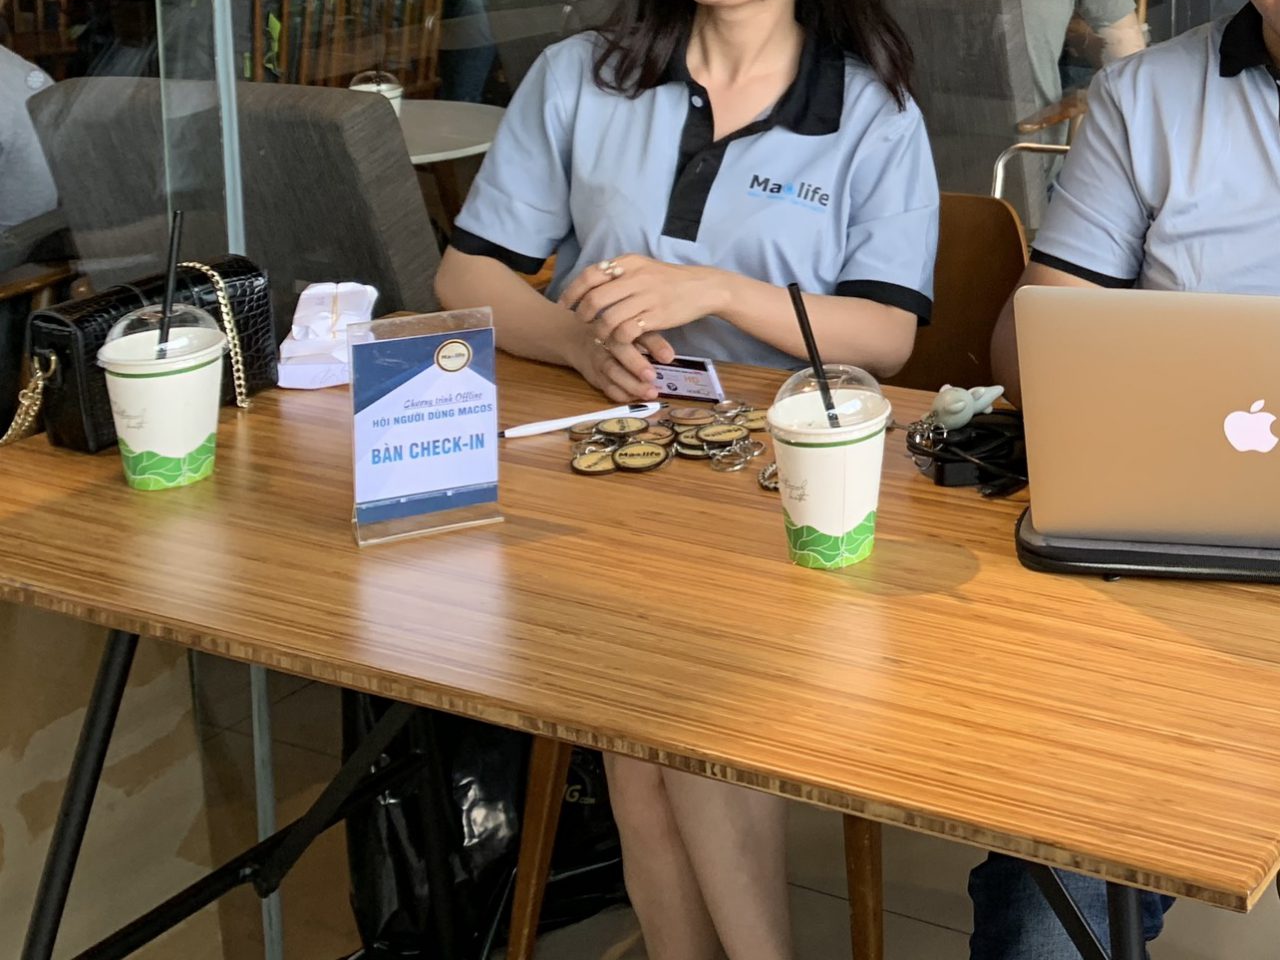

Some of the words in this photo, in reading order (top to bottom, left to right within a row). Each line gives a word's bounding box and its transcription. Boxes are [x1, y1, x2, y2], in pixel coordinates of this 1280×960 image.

[458, 403, 493, 416] MACOS
[371, 442, 404, 465] BÀN
[409, 432, 485, 459] CHECK-IN
